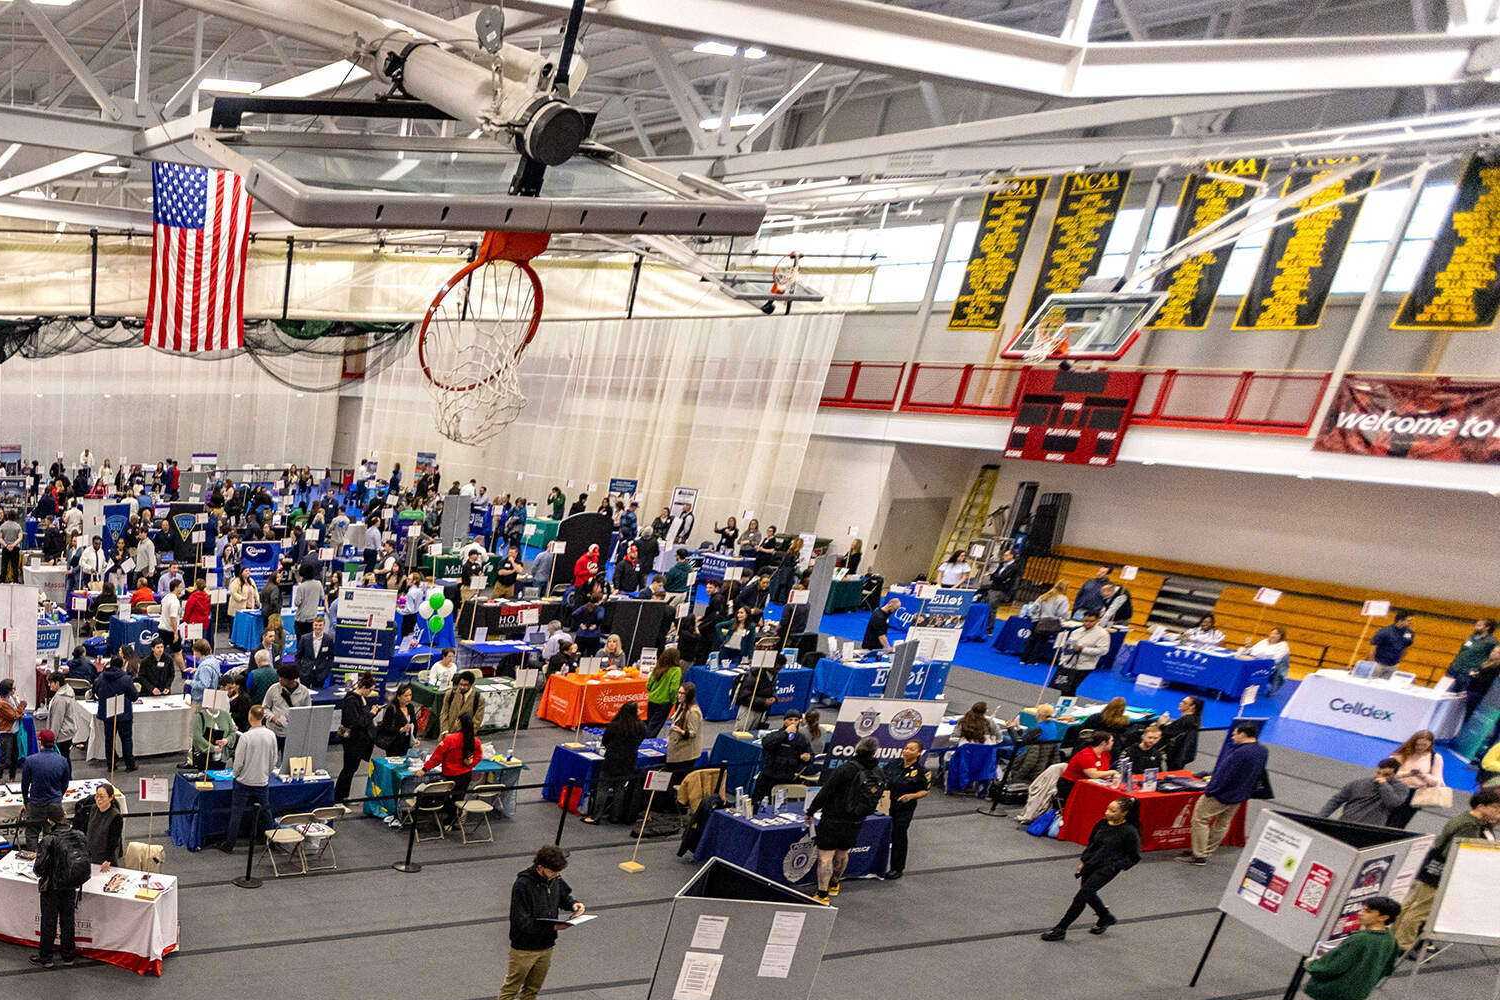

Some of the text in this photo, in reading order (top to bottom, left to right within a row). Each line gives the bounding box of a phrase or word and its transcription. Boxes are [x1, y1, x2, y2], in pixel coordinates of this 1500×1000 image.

[1204, 158, 1257, 175] NCAA
[1073, 174, 1120, 191] NCAA
[1061, 402, 1083, 411] PERIOD
[1013, 426, 1030, 434] FOULS
[1337, 409, 1493, 439] welcome to
[1045, 427, 1082, 438] PLAYER FOUL
[1097, 431, 1118, 440] FOULS
[1005, 450, 1023, 458] SCORE
[929, 594, 963, 606] Eliot
[871, 666, 925, 688] Eot
[775, 683, 795, 695] ank
[603, 691, 649, 703] easterseals
[1329, 697, 1396, 722] Celldex
[850, 846, 871, 854] POLICE
